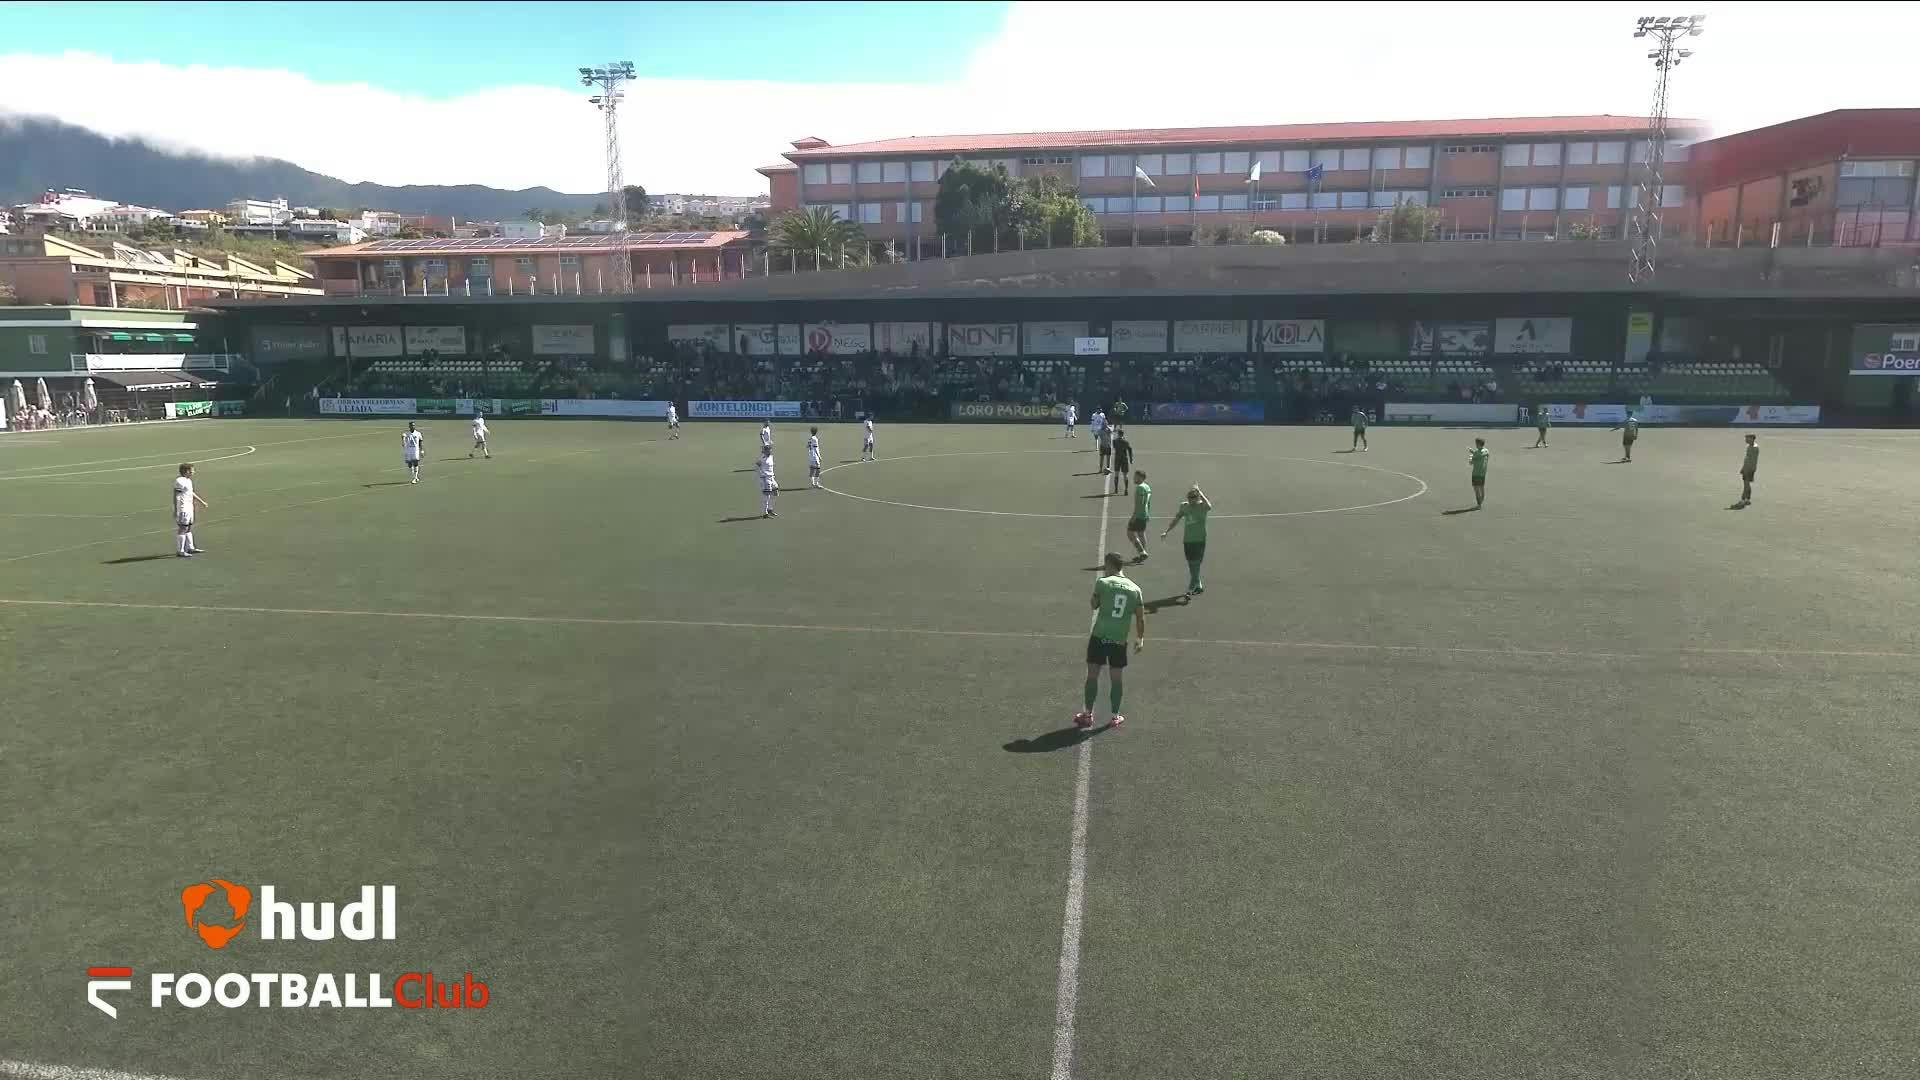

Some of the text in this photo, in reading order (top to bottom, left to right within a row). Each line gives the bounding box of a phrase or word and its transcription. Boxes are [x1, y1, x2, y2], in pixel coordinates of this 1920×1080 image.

[959, 405, 1049, 416] LORO PARQUE
[1112, 594, 1128, 618] 9
